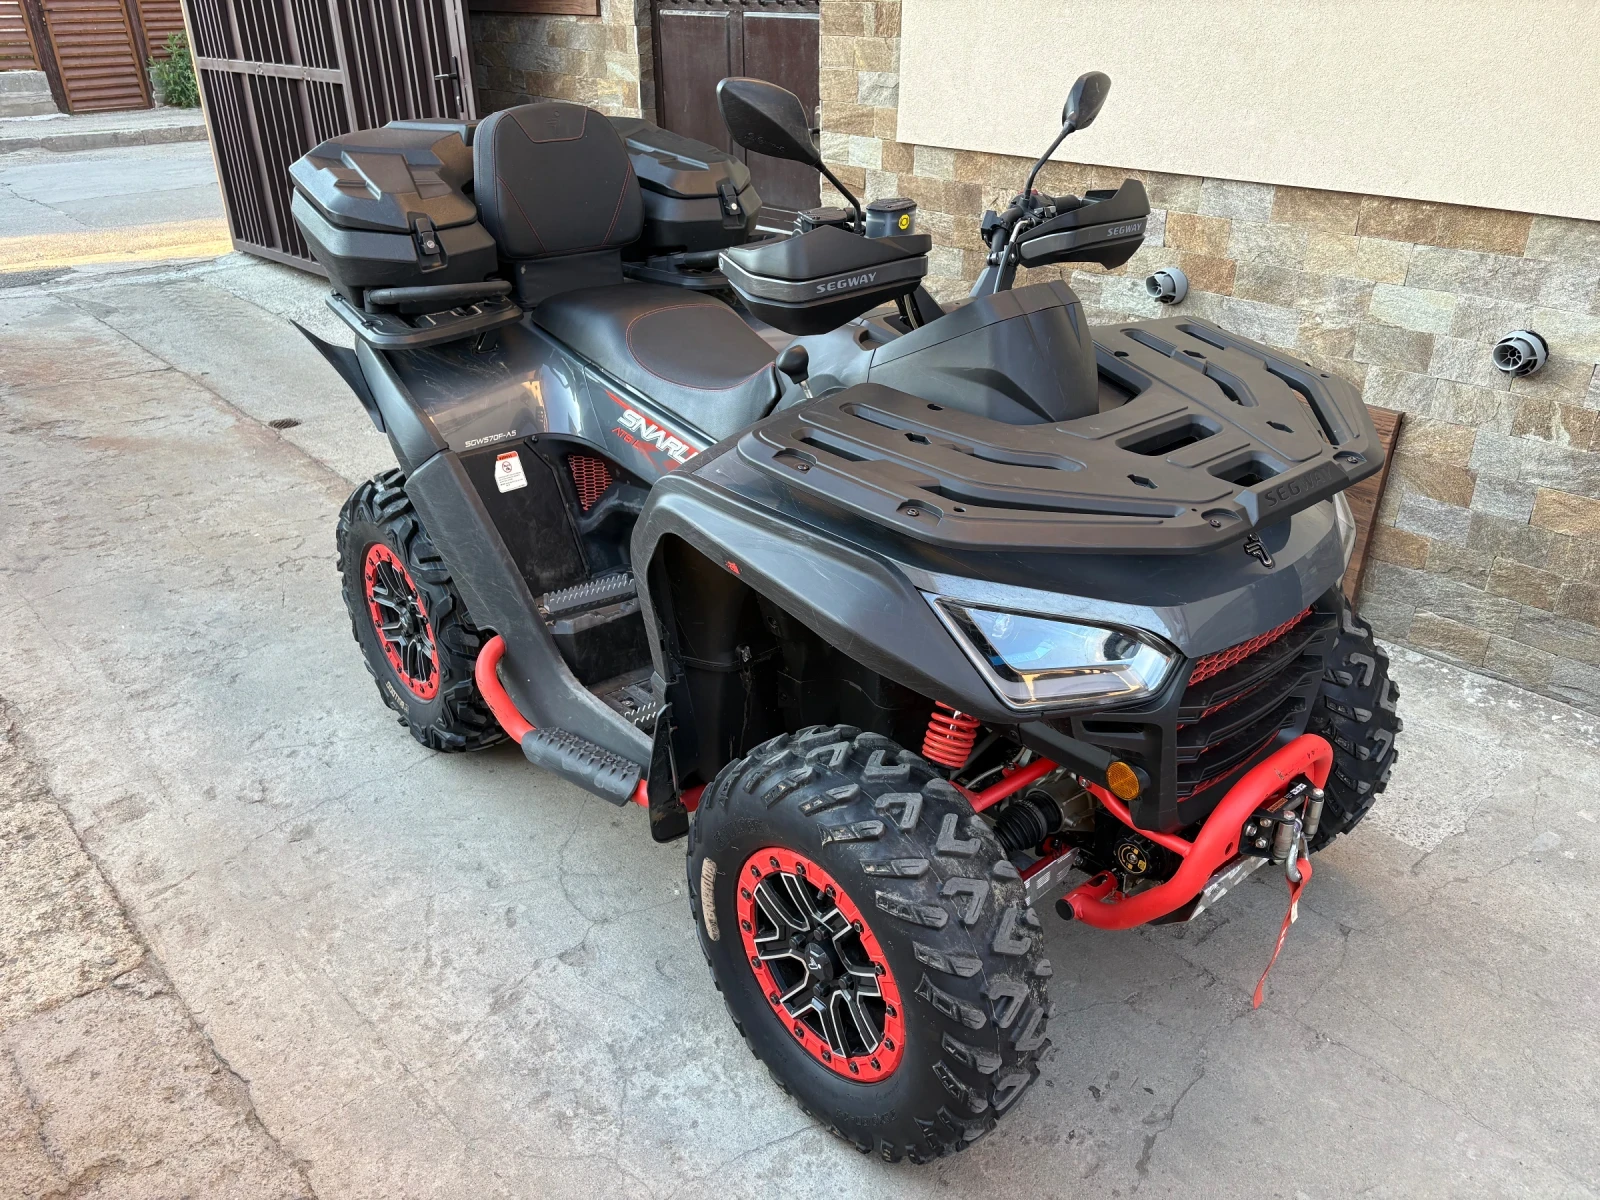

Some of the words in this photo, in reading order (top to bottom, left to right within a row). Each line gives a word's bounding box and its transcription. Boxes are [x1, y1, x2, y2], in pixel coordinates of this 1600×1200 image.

[1107, 222, 1142, 237] SEGWAY
[816, 271, 877, 294] SEGWAY
[464, 429, 517, 448] SGW570F-A5
[616, 409, 700, 465] SNARL
[1264, 463, 1333, 507] SEGWAY
